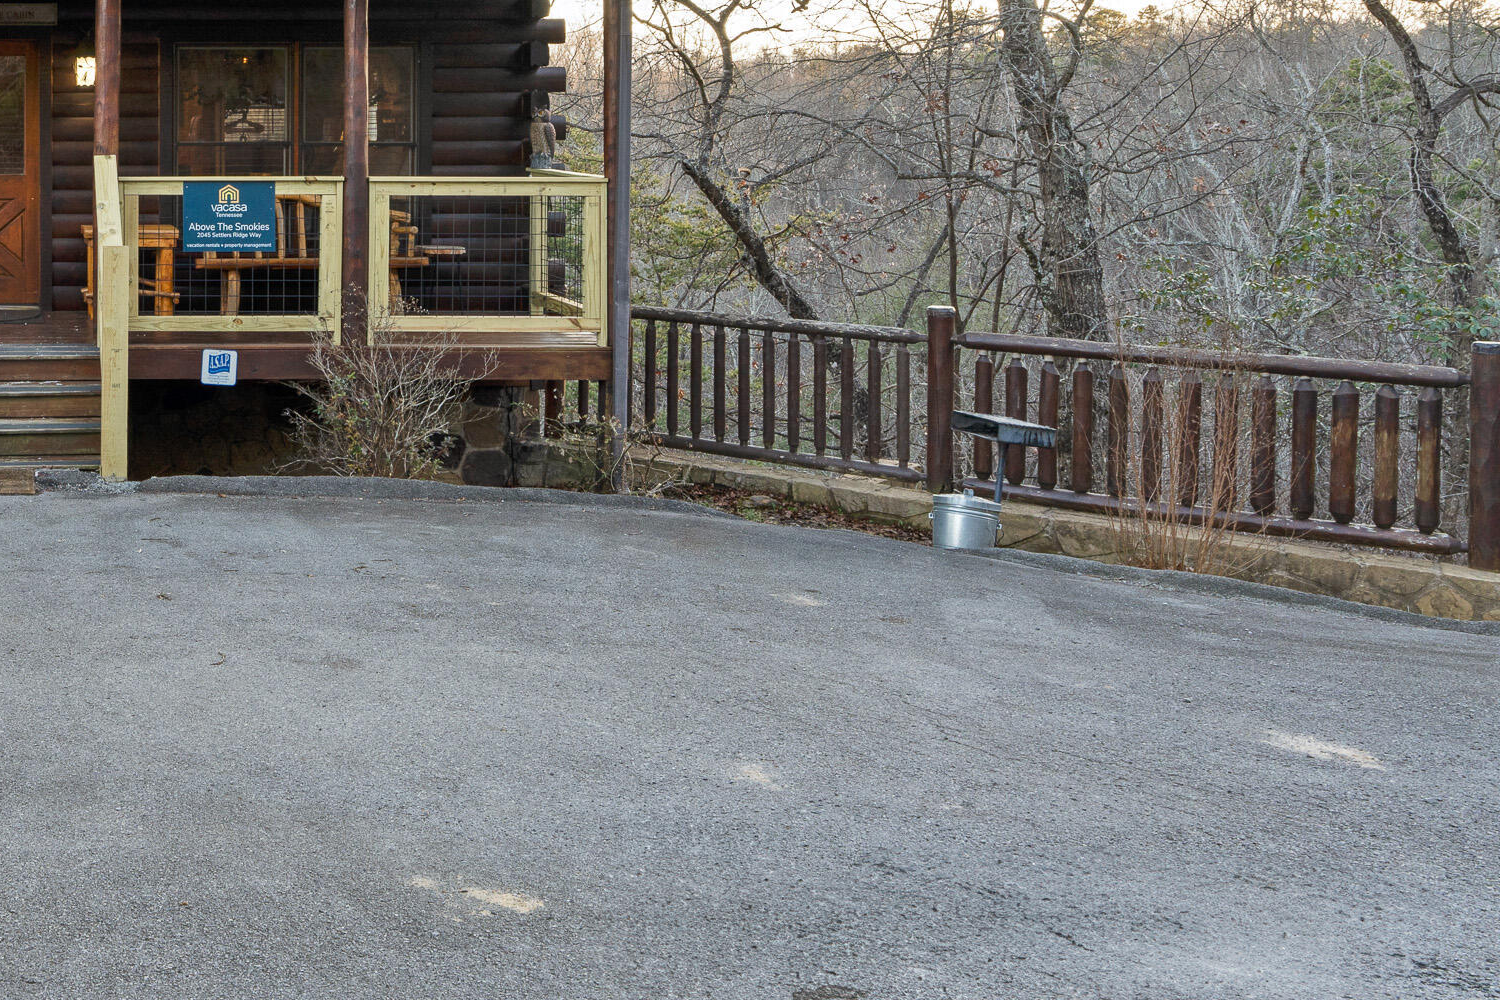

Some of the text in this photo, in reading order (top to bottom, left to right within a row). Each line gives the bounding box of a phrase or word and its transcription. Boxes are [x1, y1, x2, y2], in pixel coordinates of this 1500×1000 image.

[211, 203, 247, 212] vacasa
[188, 222, 270, 231] Above The Smokies
